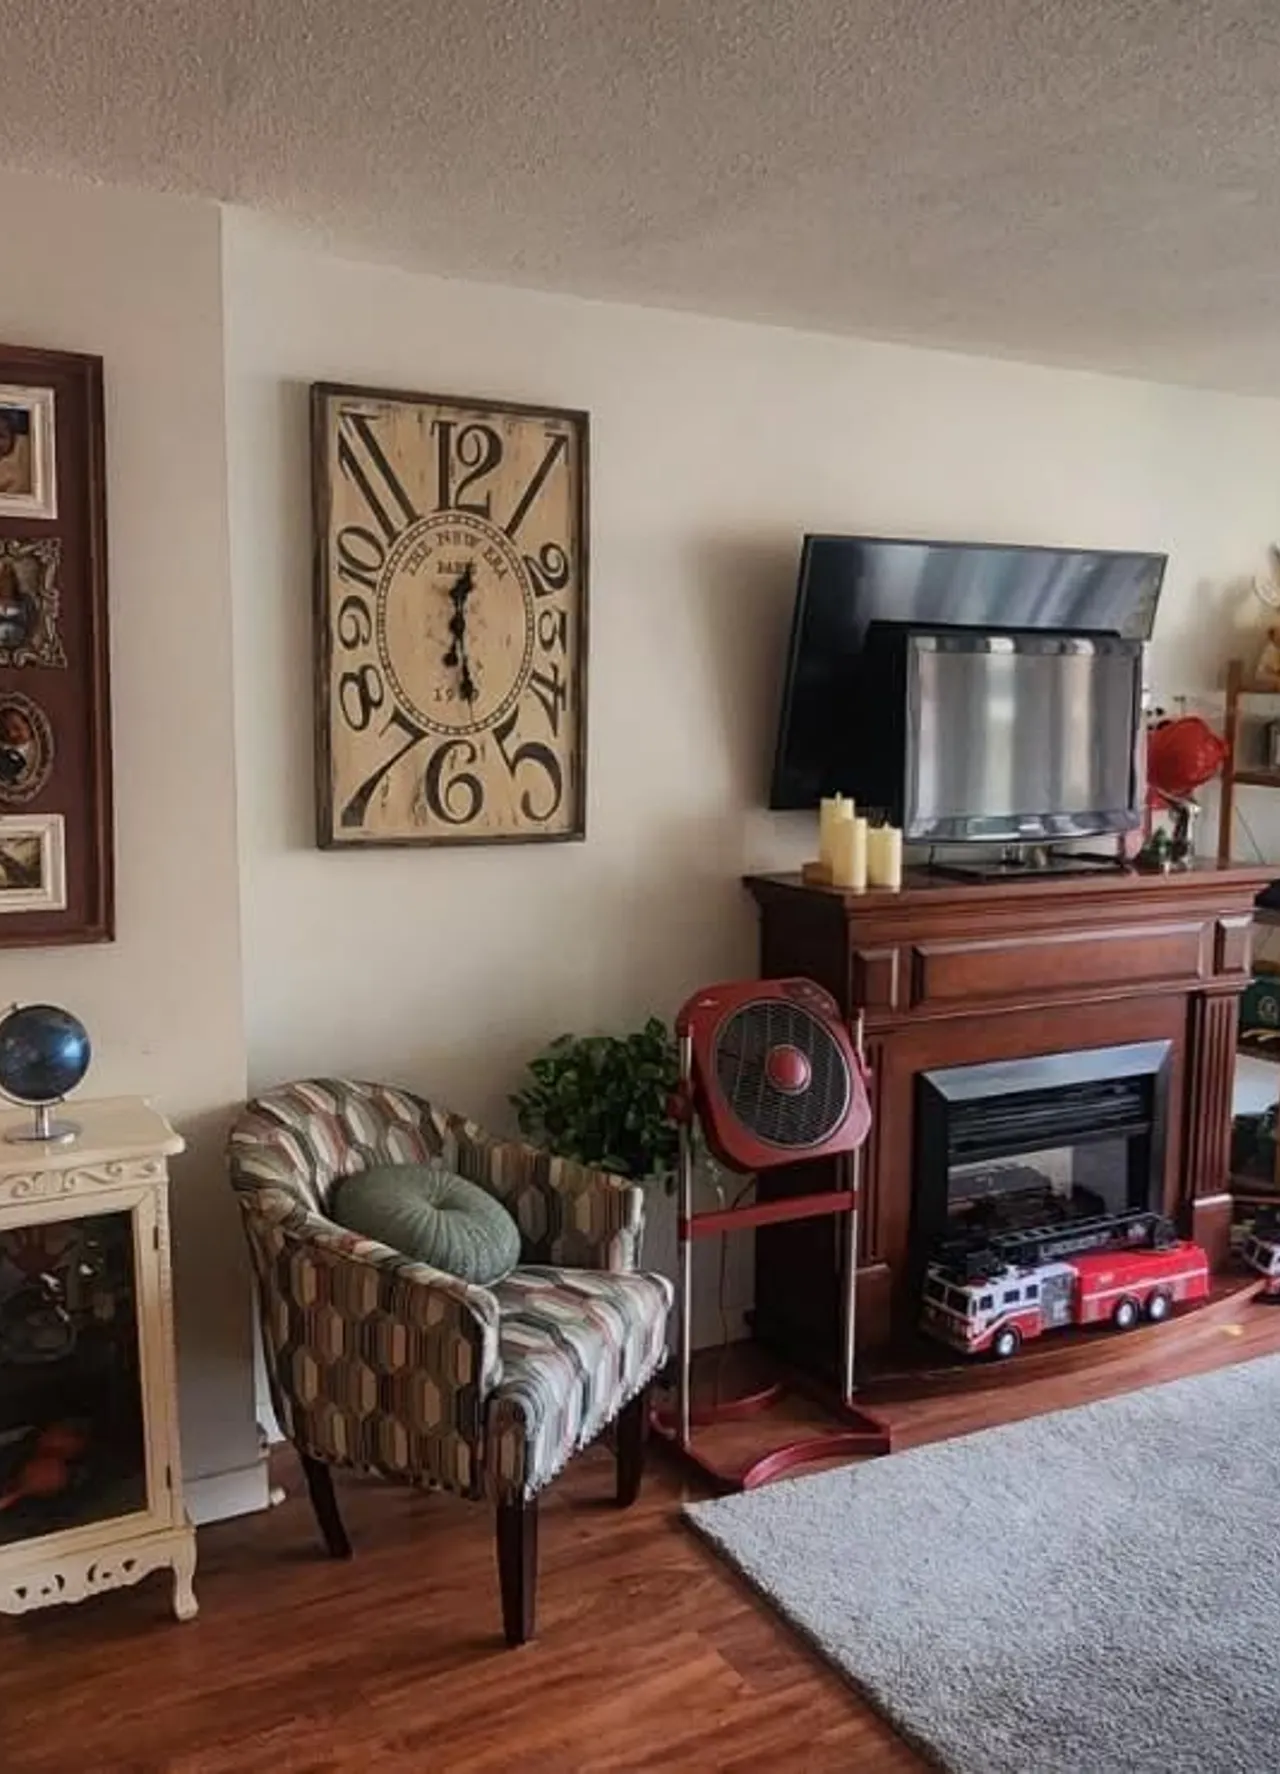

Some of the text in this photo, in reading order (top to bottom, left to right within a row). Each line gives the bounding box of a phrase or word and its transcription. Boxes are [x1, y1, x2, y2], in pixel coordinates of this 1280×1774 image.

[430, 420, 503, 519] 12
[502, 432, 569, 541] 1
[336, 526, 386, 593] 10
[522, 542, 569, 598] 2
[337, 595, 372, 651] 9
[339, 664, 384, 731] 8
[528, 667, 567, 739] 4
[341, 707, 429, 827] 7
[425, 739, 484, 824] 6
[491, 701, 562, 822] 5
